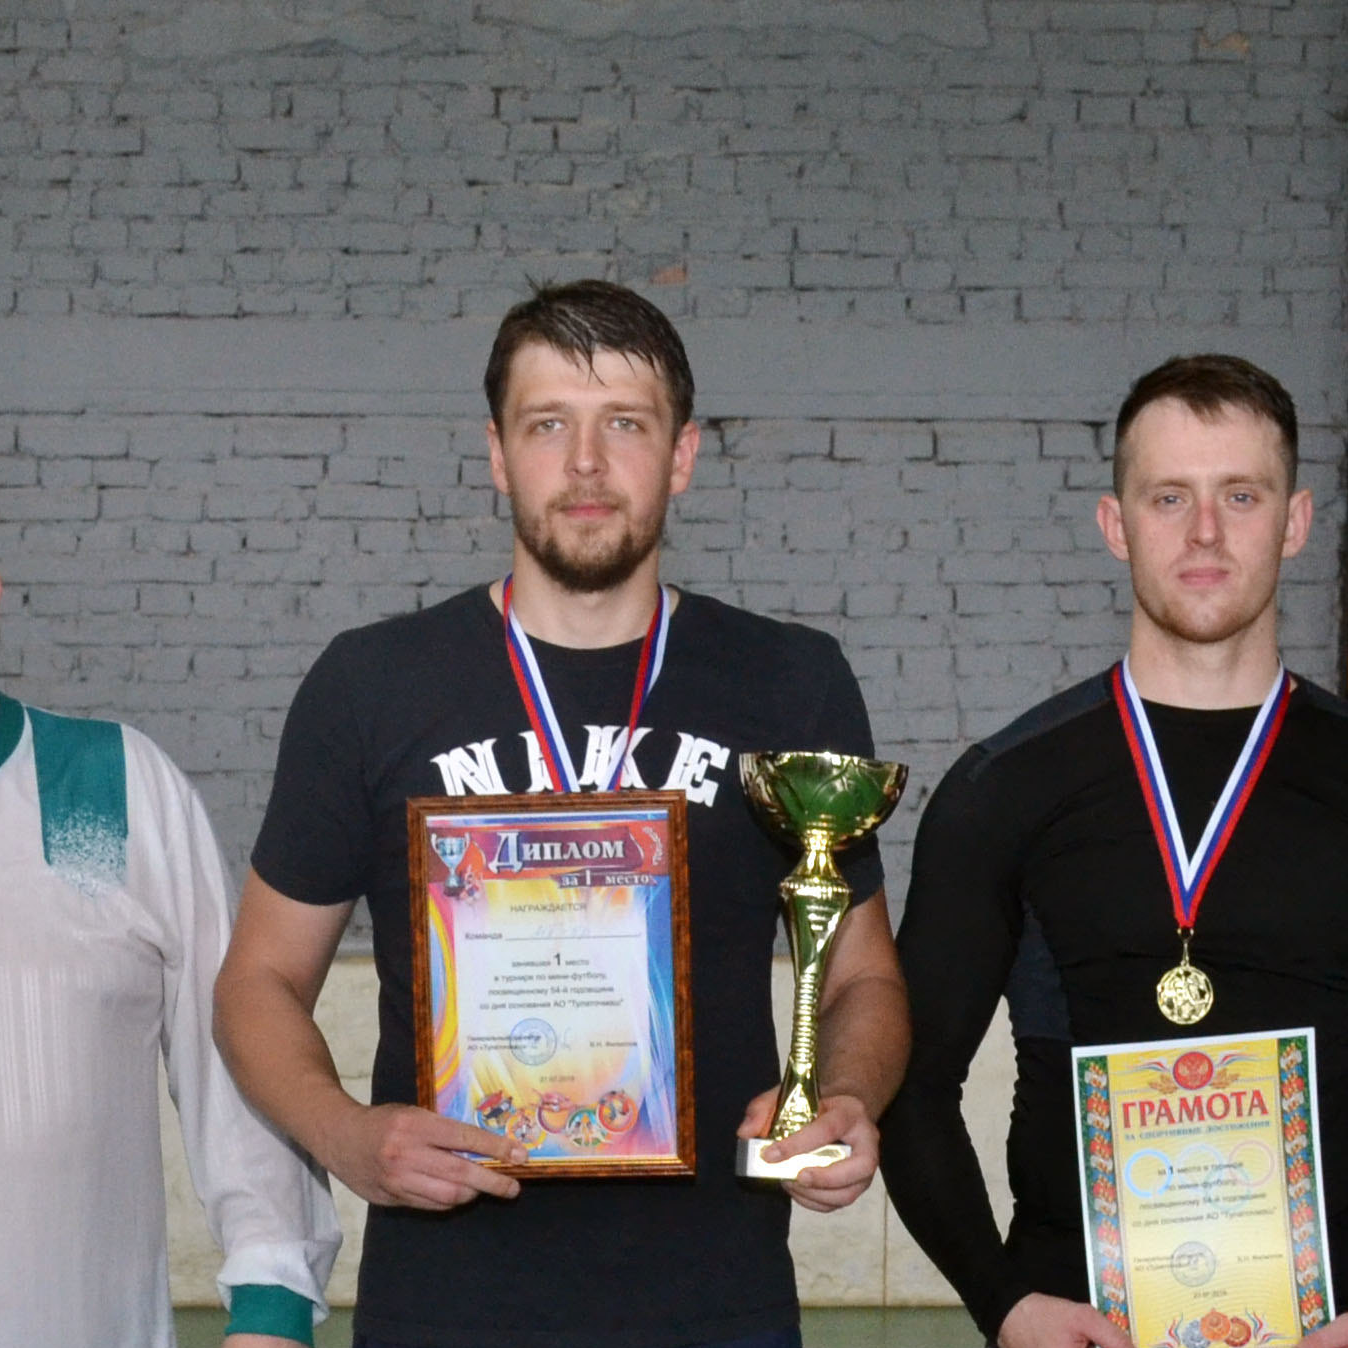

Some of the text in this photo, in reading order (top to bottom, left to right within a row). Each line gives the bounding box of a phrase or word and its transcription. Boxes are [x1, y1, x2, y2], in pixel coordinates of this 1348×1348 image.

[605, 873, 649, 885] место
[510, 903, 587, 912] НАГРАЖДАЕТСЯ
[554, 953, 561, 966] 1
[1122, 1089, 1269, 1129] ГРАМОТА
